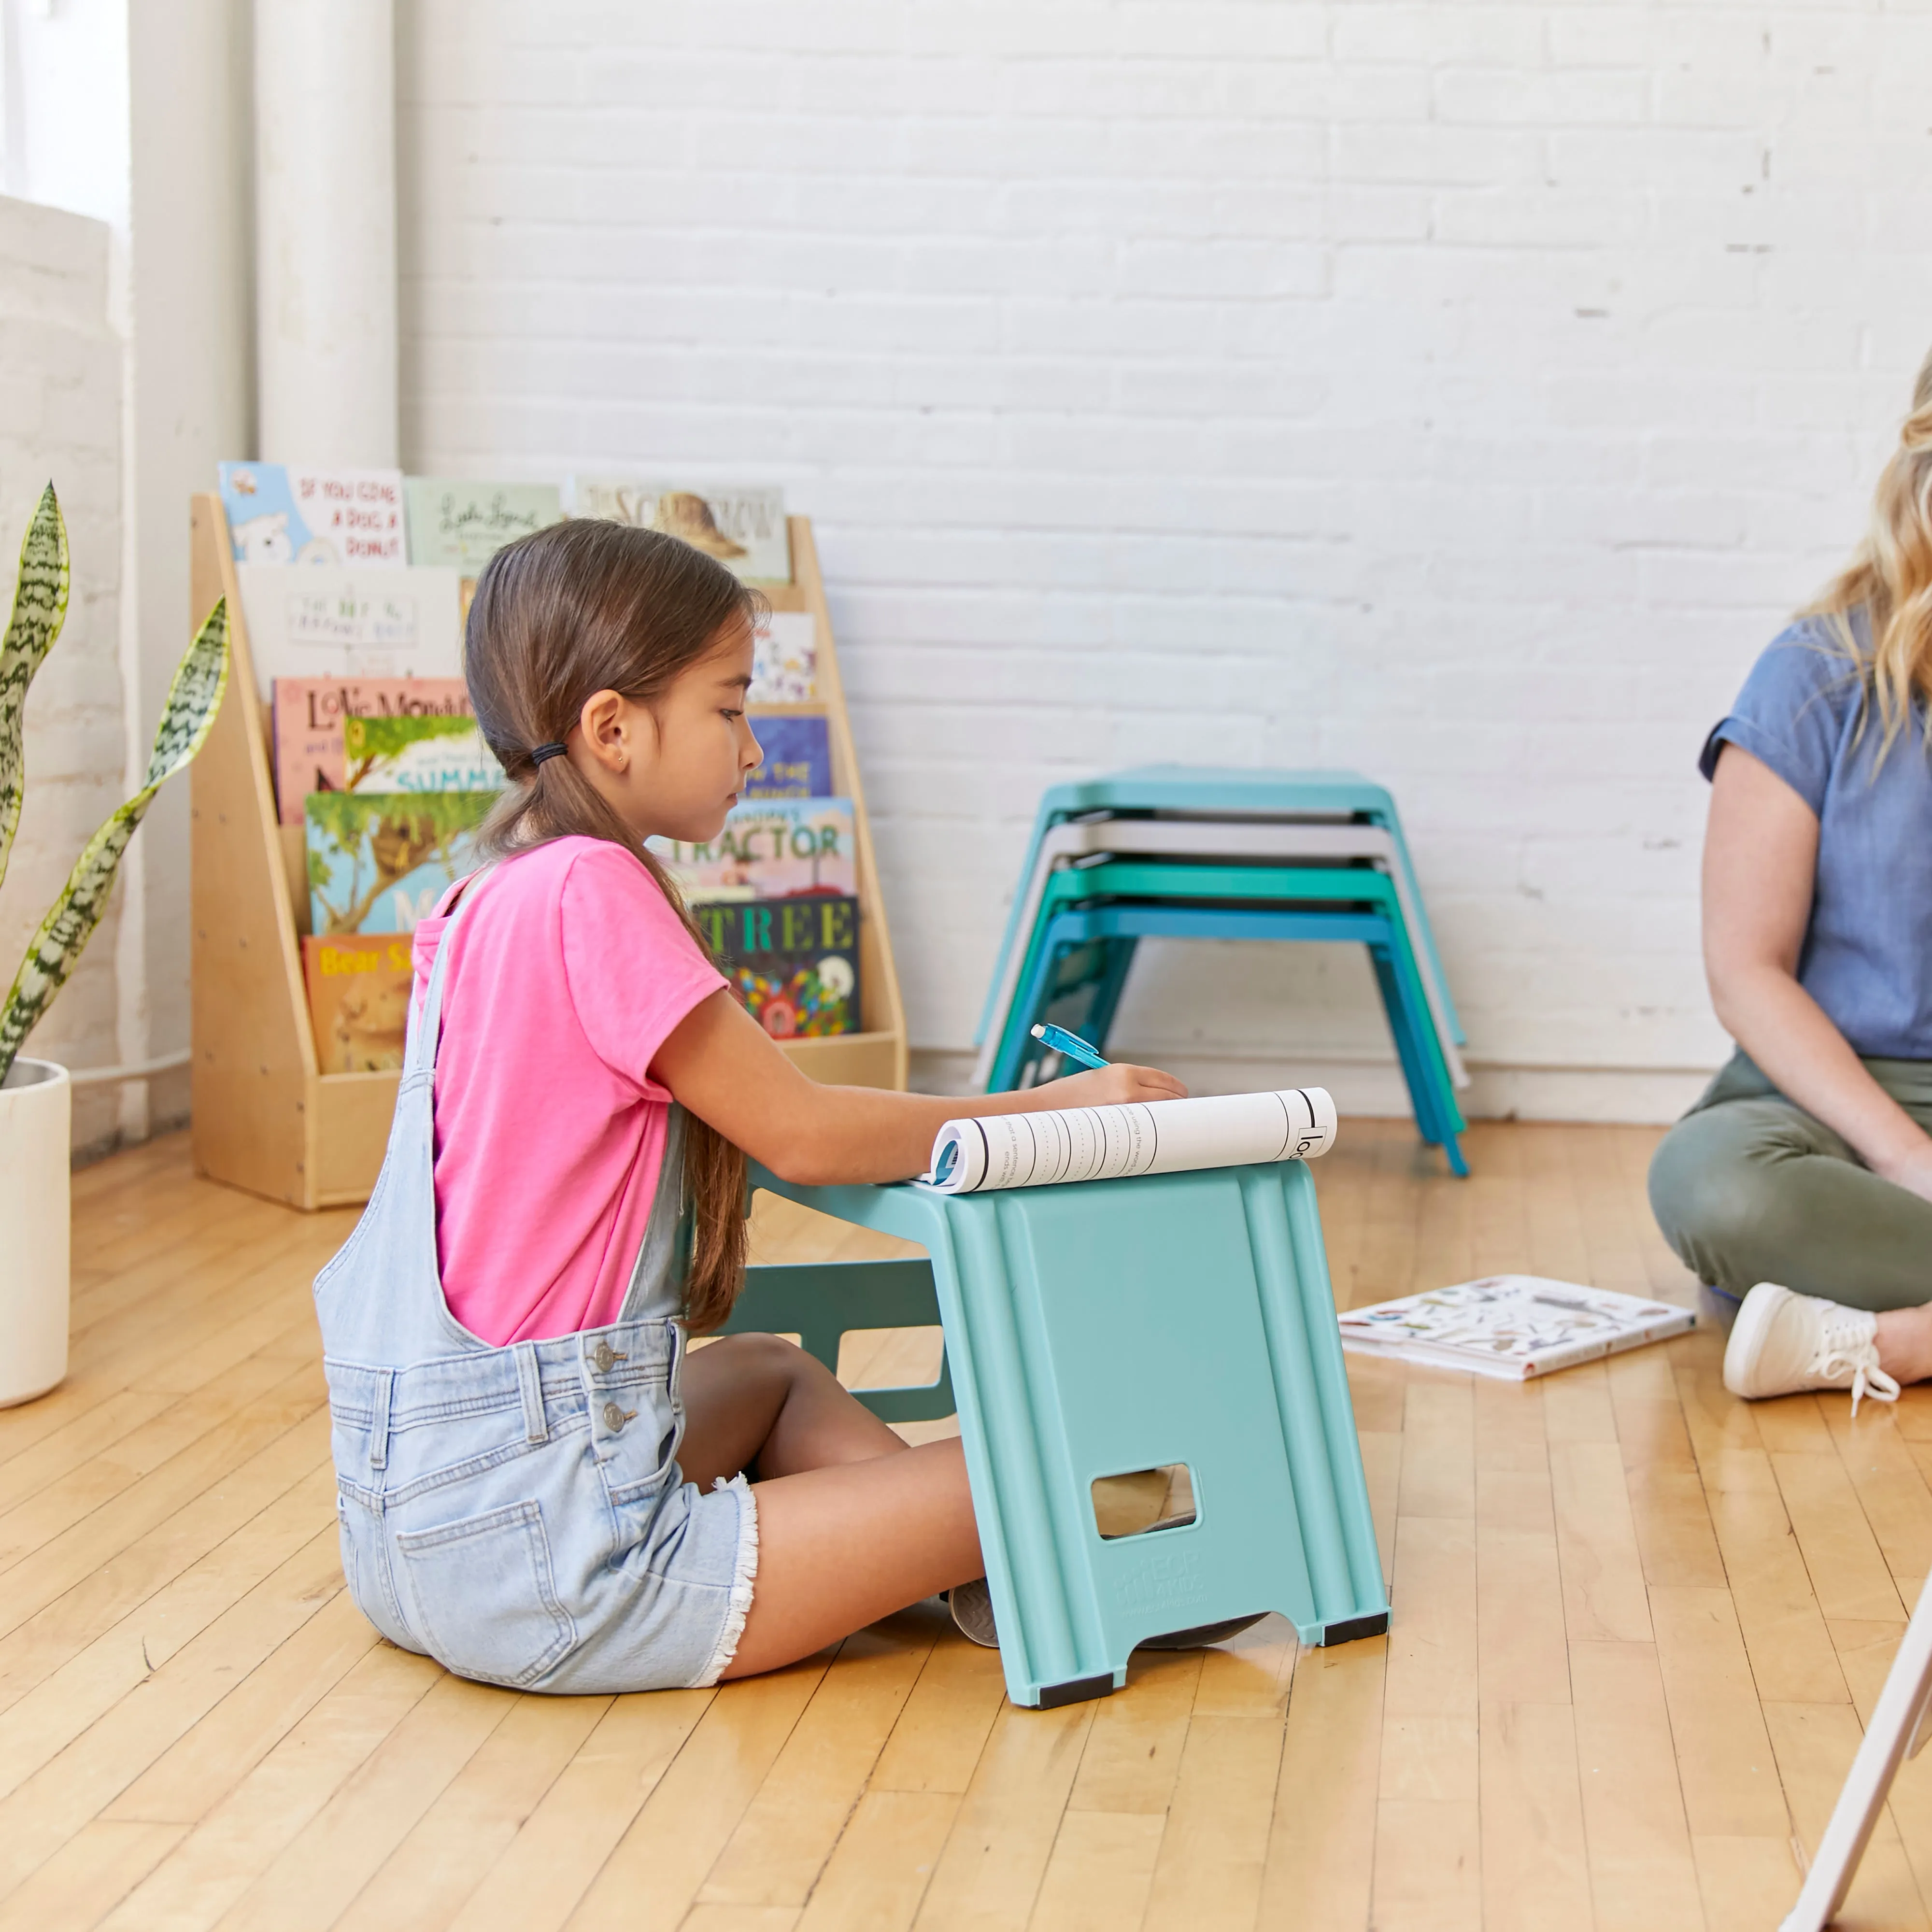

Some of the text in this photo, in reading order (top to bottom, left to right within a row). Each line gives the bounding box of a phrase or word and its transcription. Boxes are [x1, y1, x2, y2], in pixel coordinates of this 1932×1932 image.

[323, 482, 354, 500] YOU
[346, 507, 383, 531] DOG
[346, 536, 399, 559] DONUT
[699, 902, 854, 954] TREE
[319, 946, 381, 976] Bear
[1132, 1116, 1140, 1135] using
[1289, 1135, 1323, 1159] loo
[1131, 1151, 1140, 1167] word
